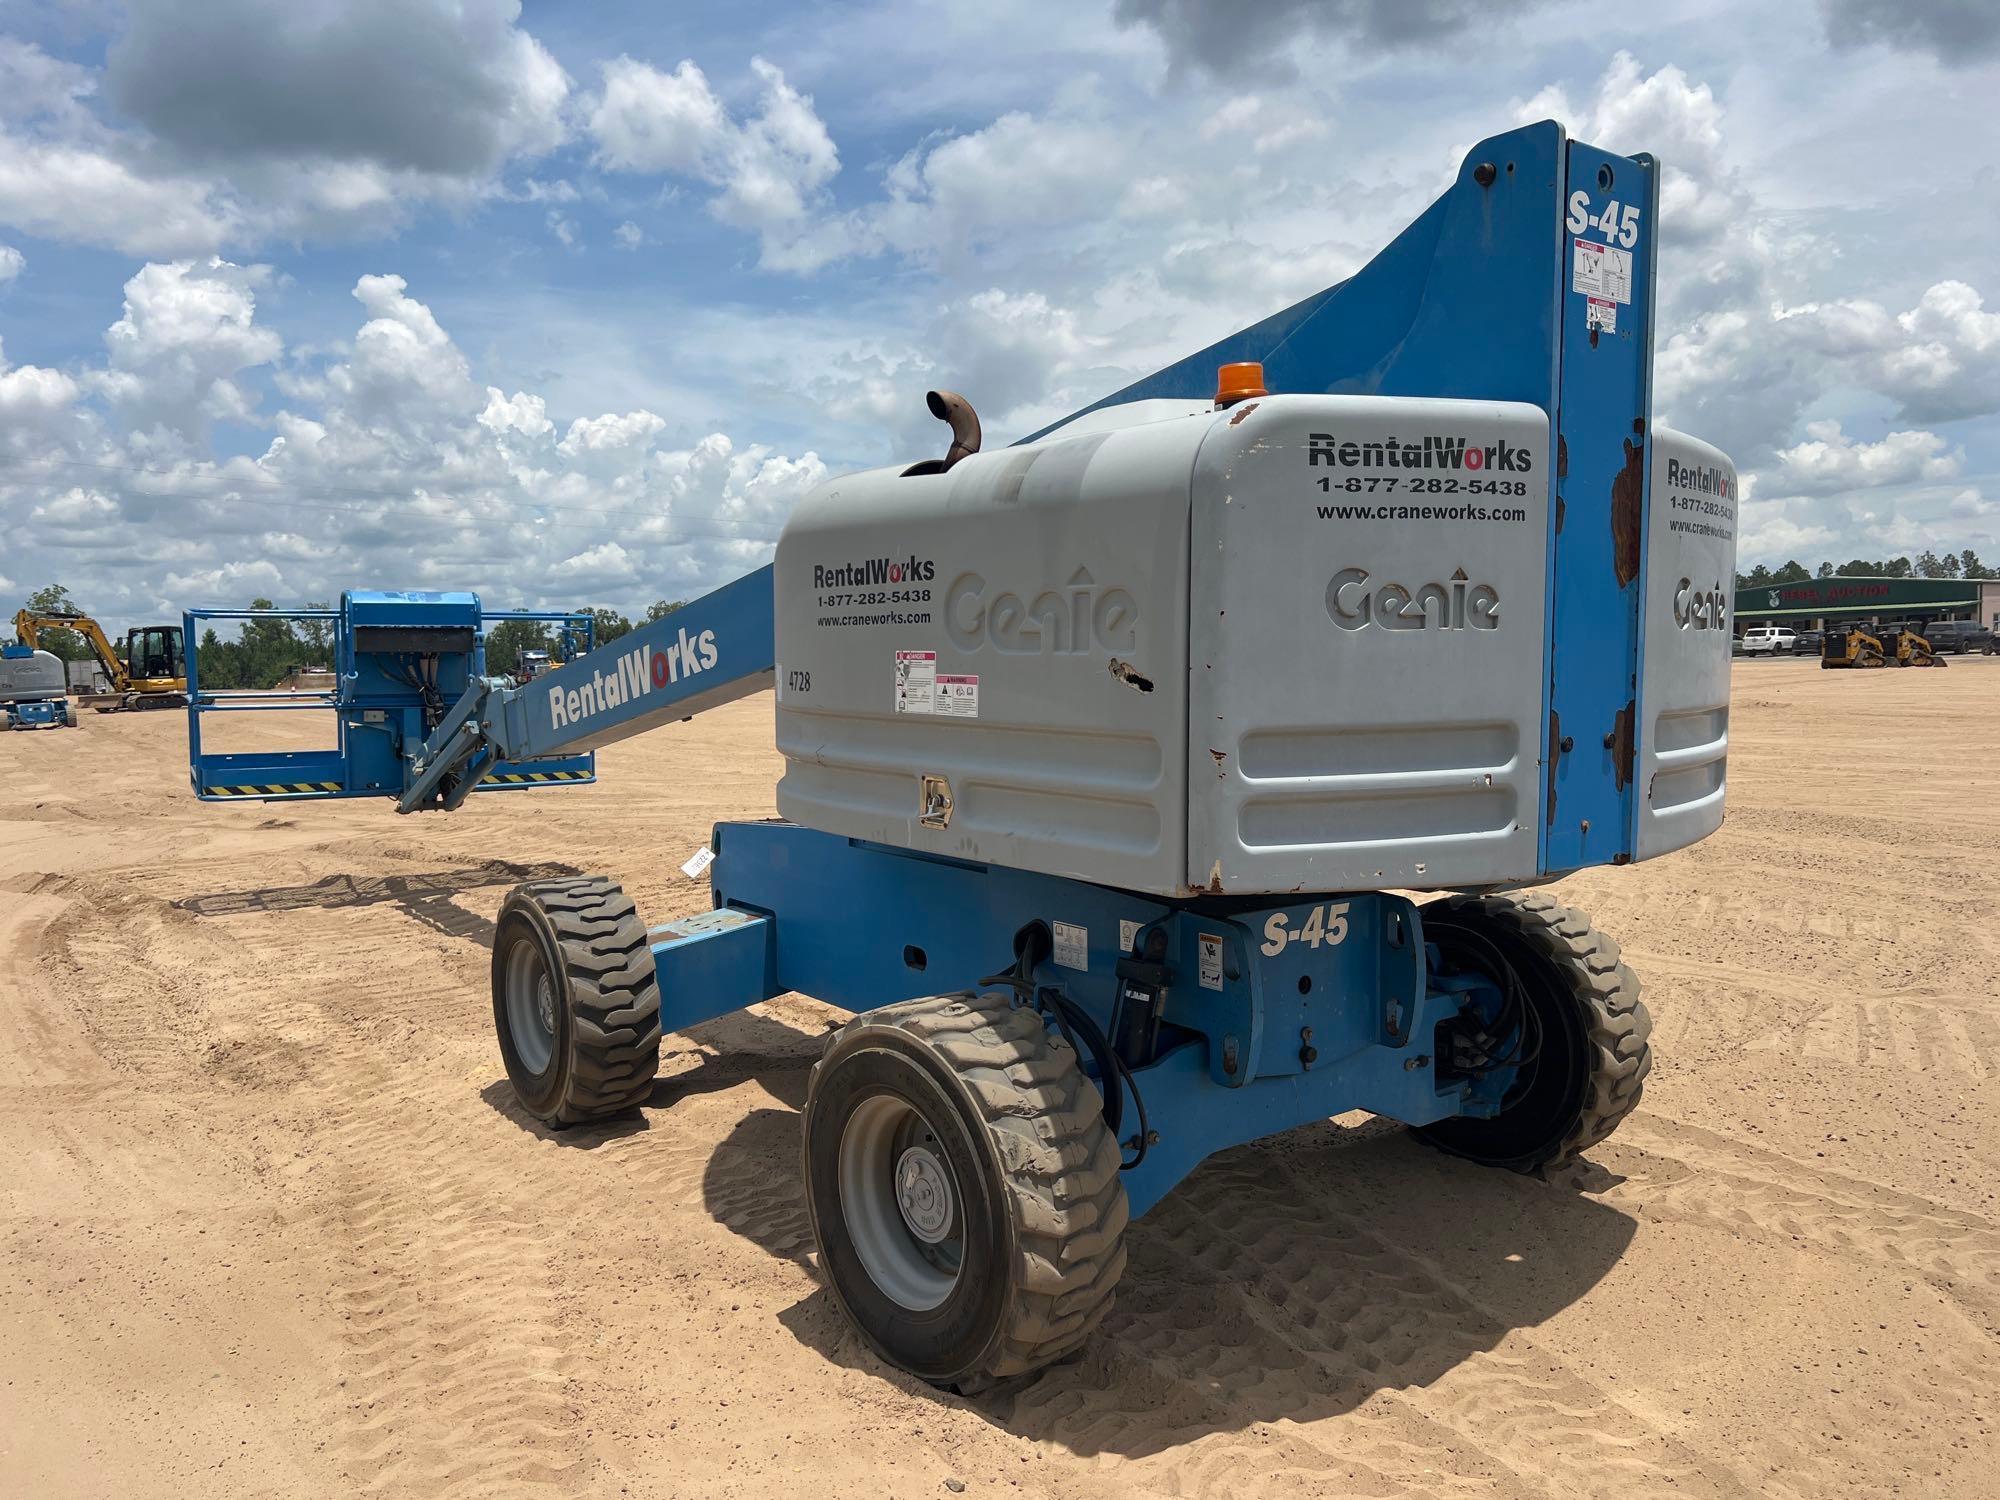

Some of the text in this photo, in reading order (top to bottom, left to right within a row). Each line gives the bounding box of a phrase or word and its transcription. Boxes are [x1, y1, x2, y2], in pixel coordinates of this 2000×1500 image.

[1566, 190, 1640, 248] S-45
[1308, 433, 1532, 472] RentalWorks
[1316, 477, 1527, 496] 1-877-282-5438
[1667, 458, 1735, 501] RentalWorks
[1316, 504, 1526, 522] www.craneworks.com
[814, 555, 935, 588] RentalWorks
[817, 589, 932, 607] 1-877-282-5438
[944, 563, 1139, 656] Genie
[1325, 566, 1500, 632] Genie
[1673, 577, 1726, 632] Genie
[817, 611, 931, 628] www.craneworks.com
[549, 627, 718, 730] RentalWorks
[789, 670, 811, 692] 4728
[1260, 902, 1350, 957] S-45
